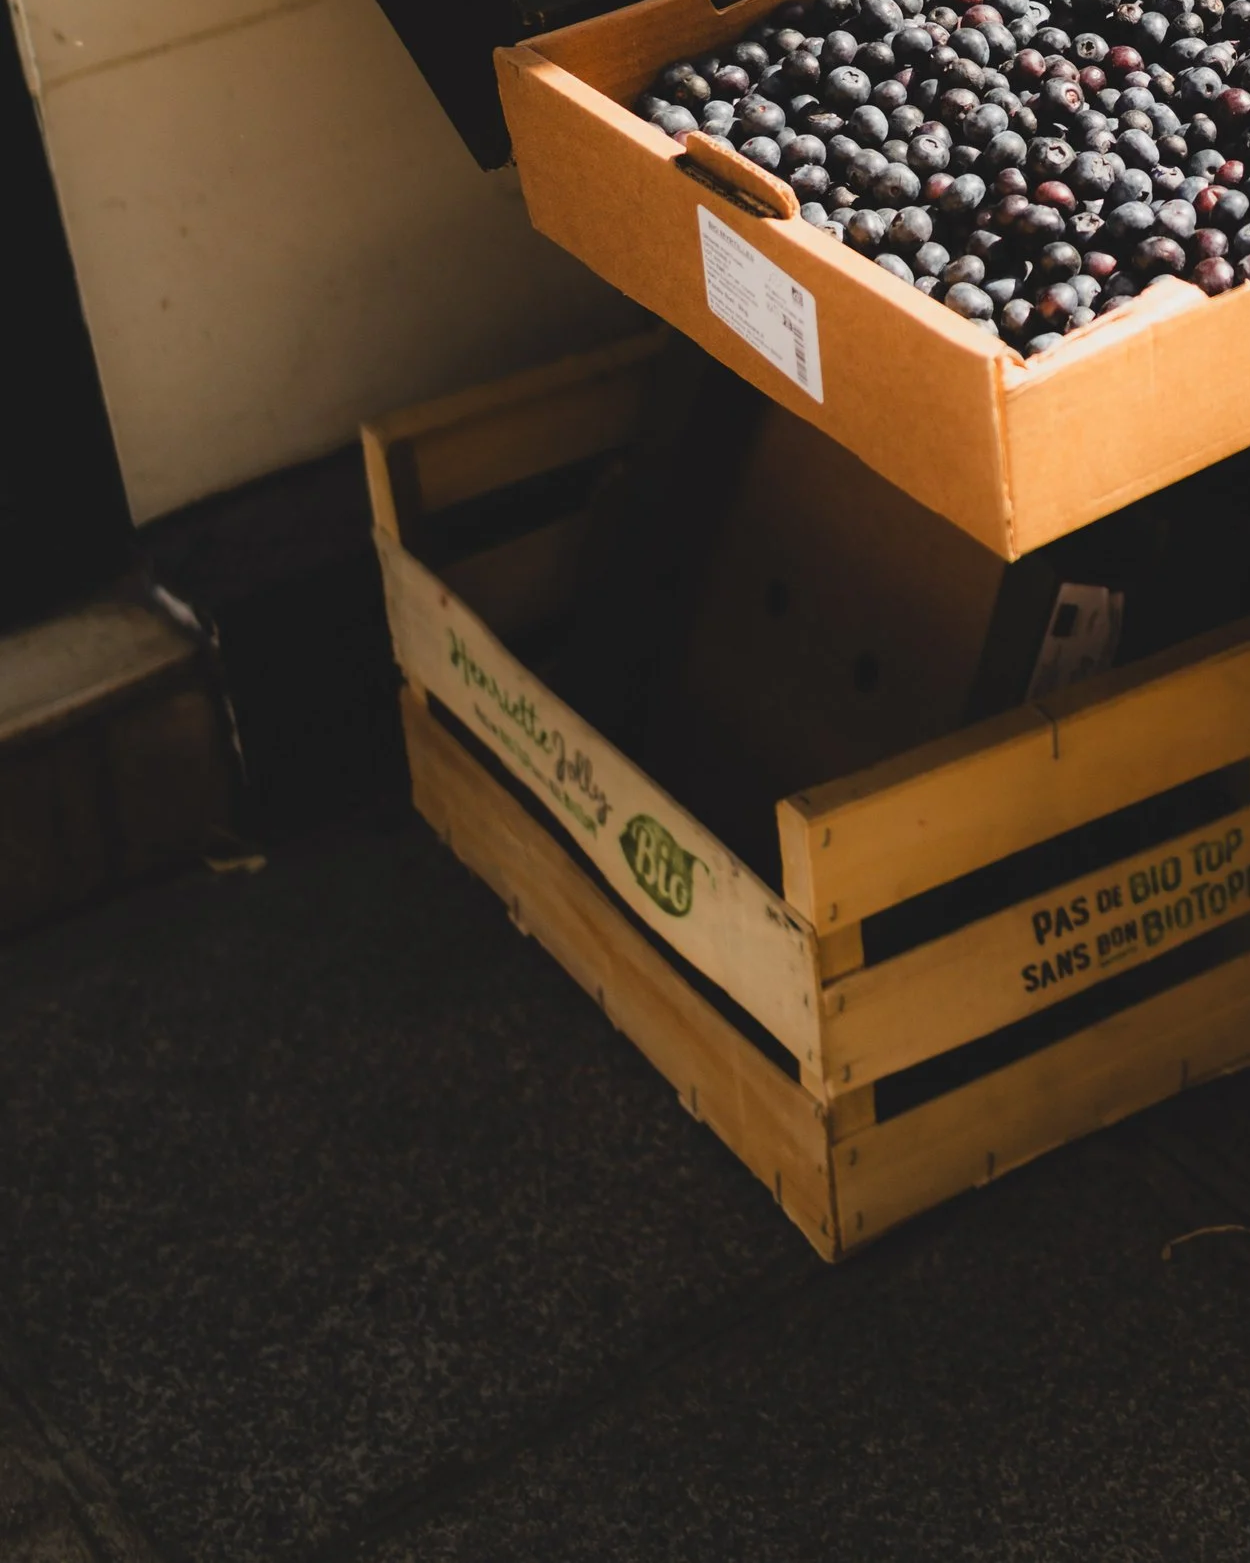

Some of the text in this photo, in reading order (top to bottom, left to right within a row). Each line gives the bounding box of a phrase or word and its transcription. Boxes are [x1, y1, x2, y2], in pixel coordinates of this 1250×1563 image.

[630, 820, 693, 910] Bio
[1031, 827, 1244, 946] PAS DE BIO TOP
[1020, 942, 1092, 994] SANS
